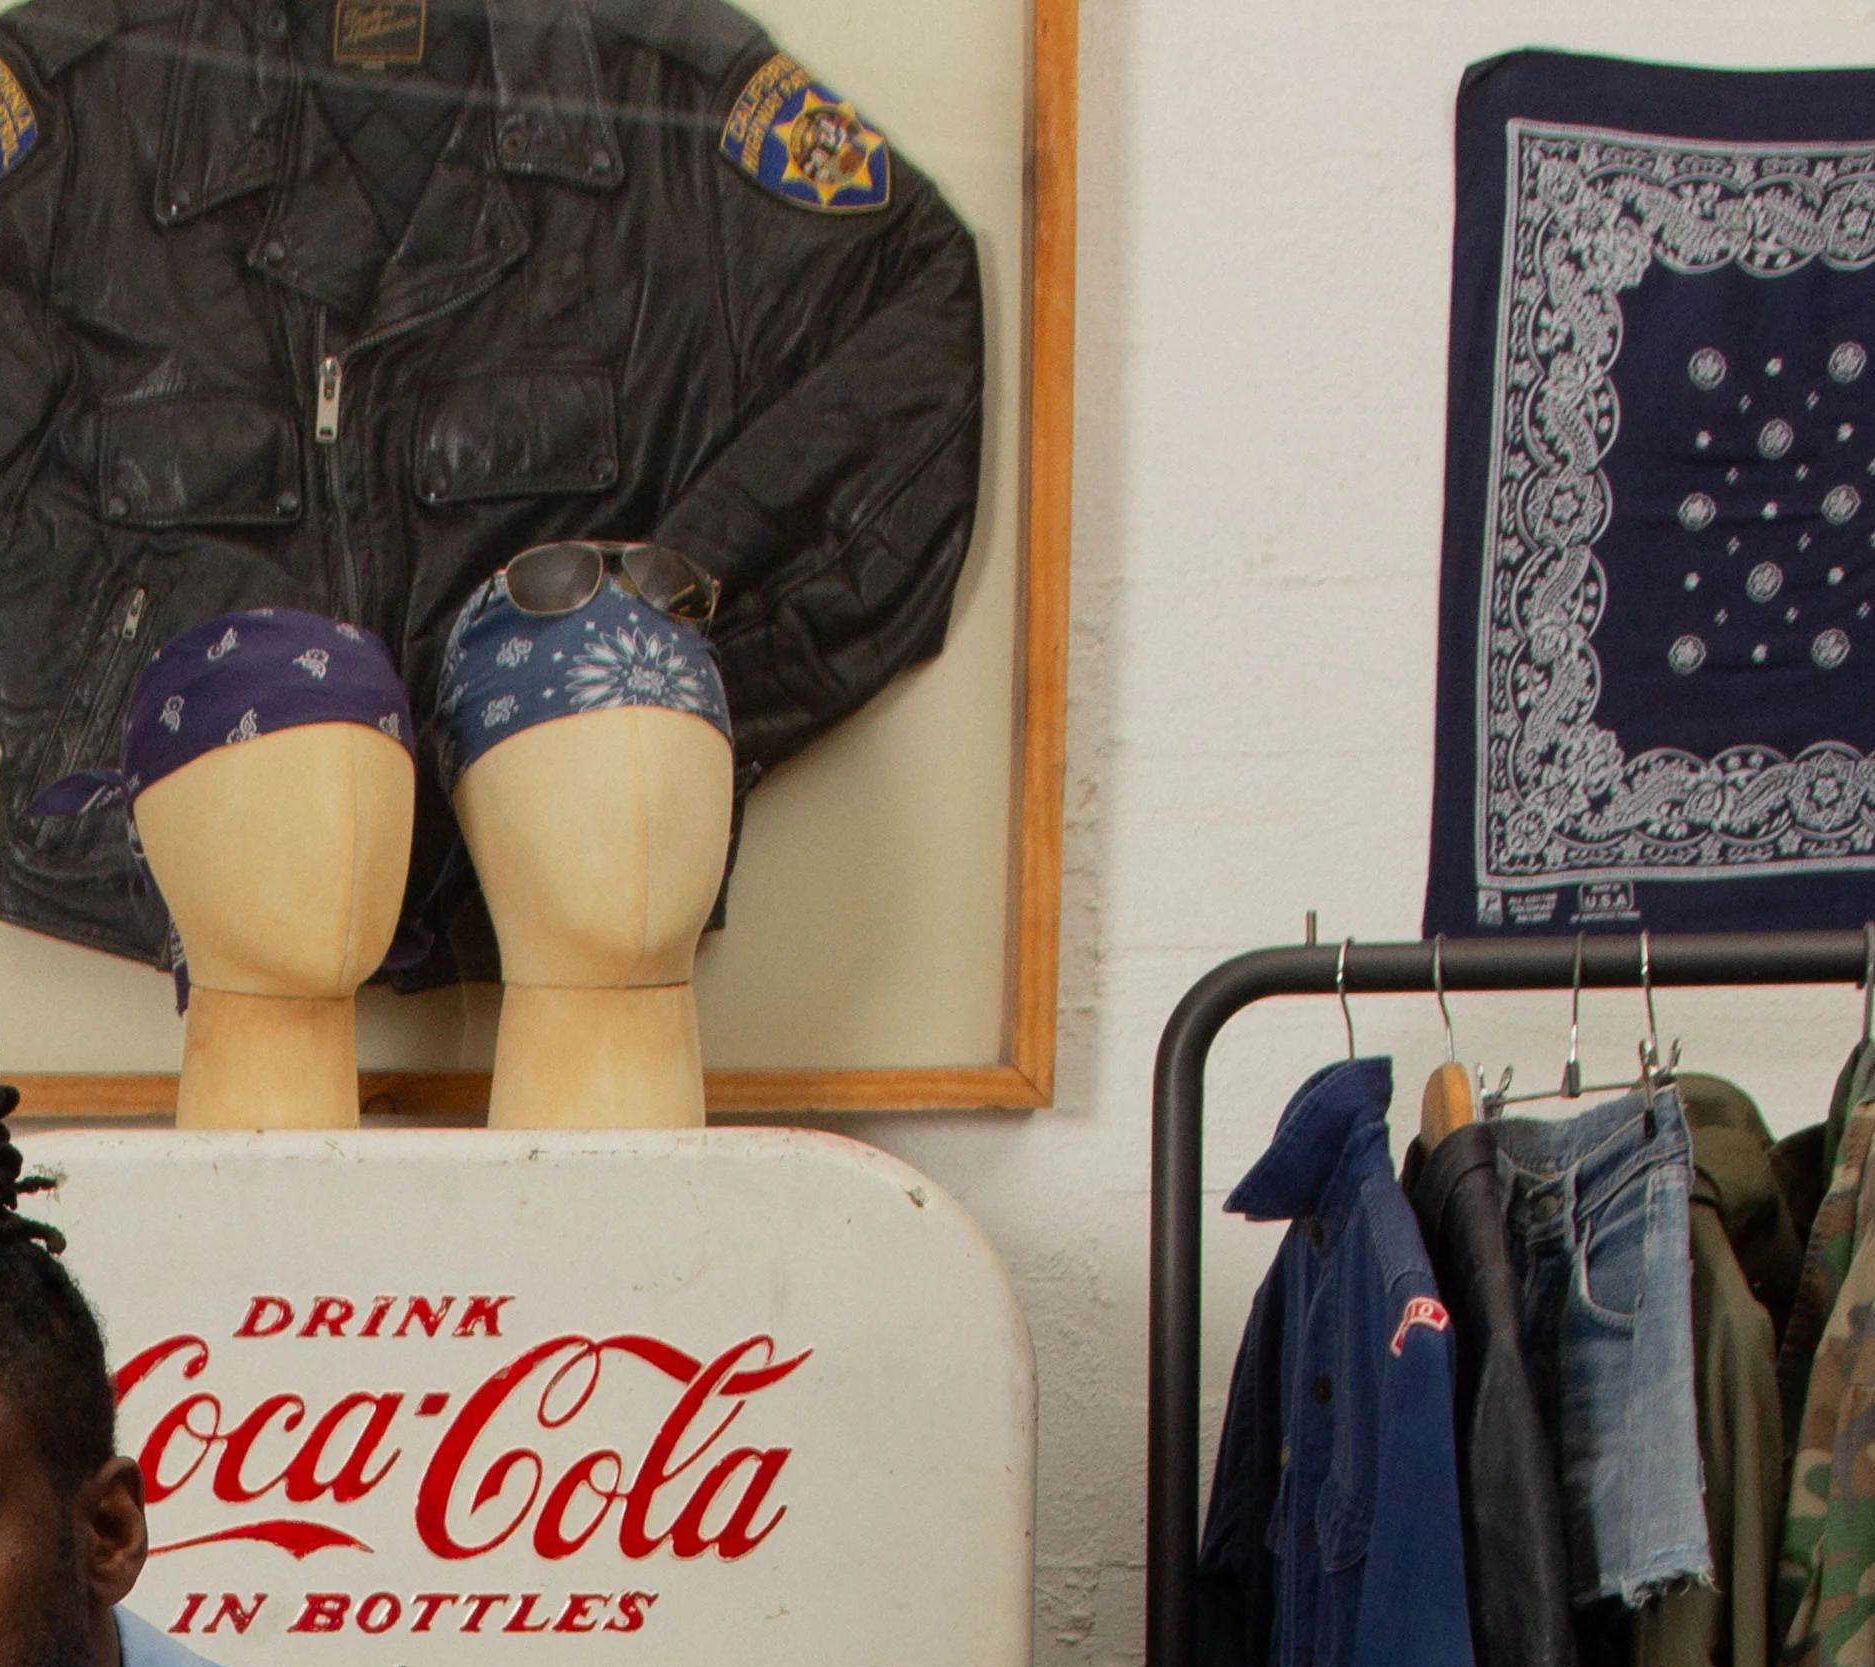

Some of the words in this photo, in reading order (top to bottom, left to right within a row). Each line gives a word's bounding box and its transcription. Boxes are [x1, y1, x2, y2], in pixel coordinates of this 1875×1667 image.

[232, 1294, 516, 1339] DRINK
[166, 1592, 270, 1634] IN
[287, 1591, 660, 1634] BOTTLES
